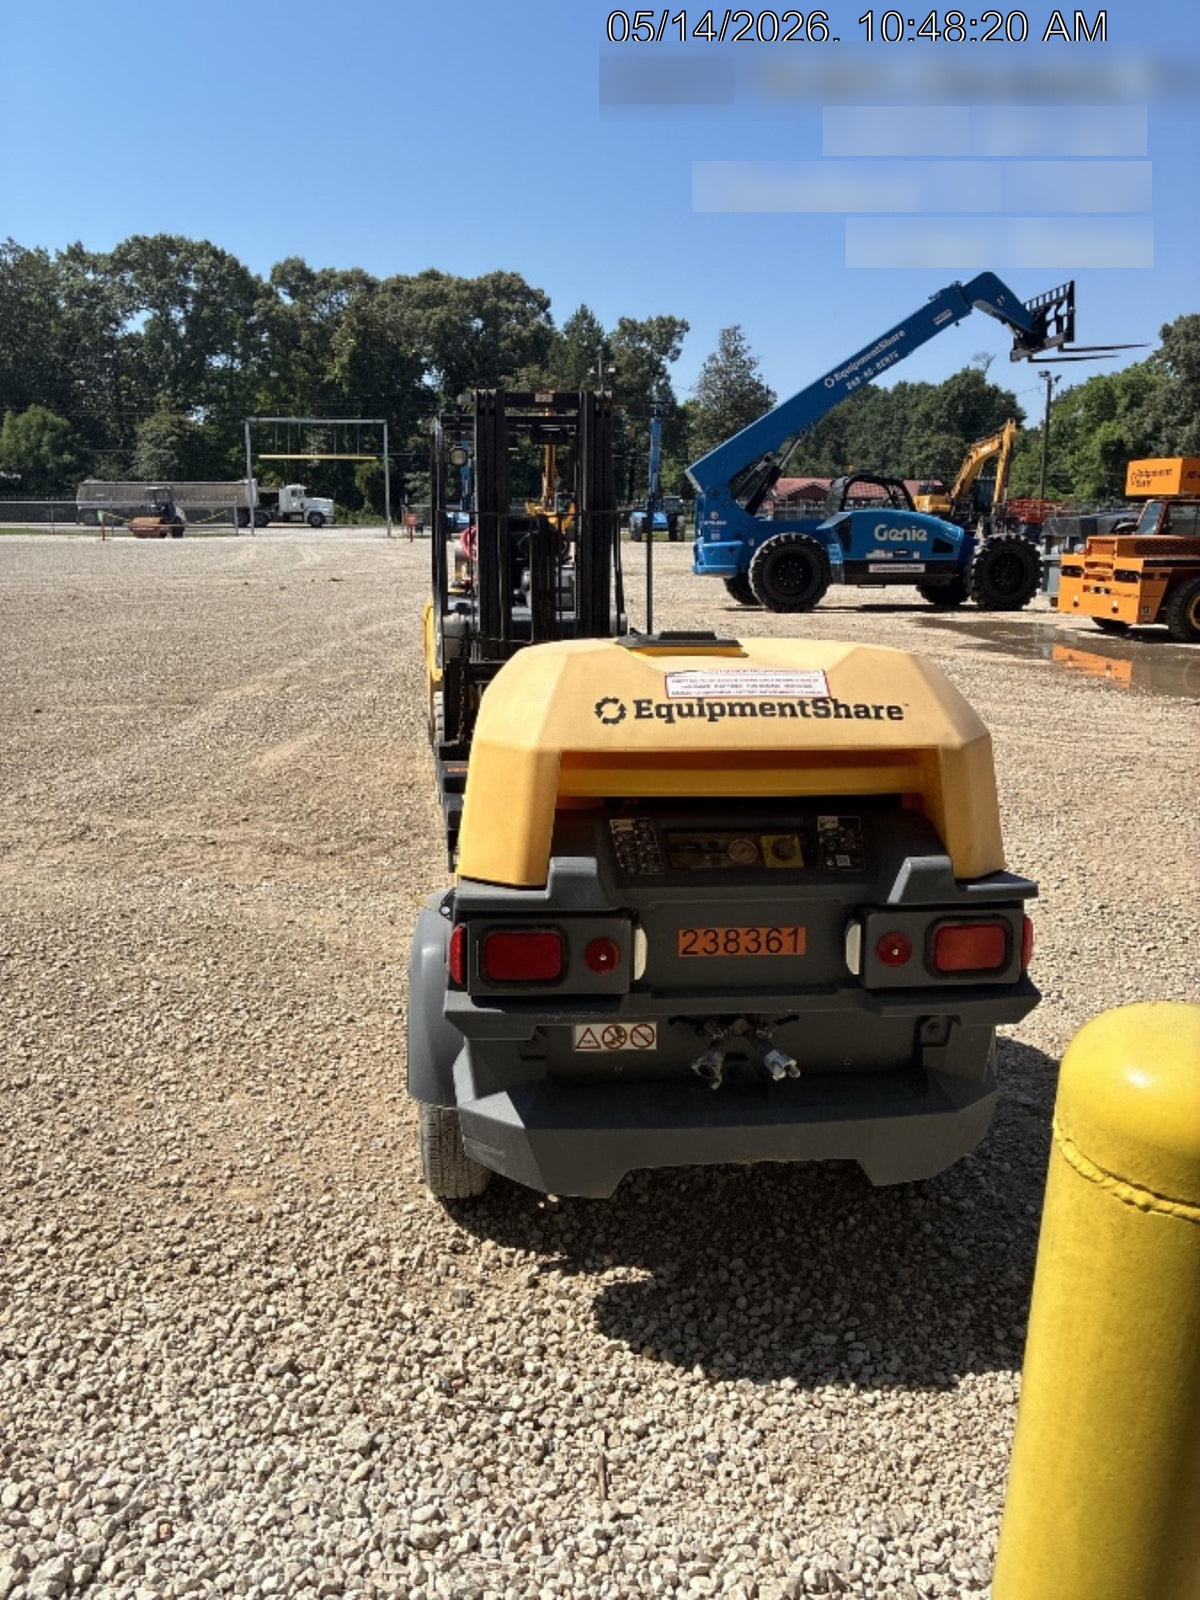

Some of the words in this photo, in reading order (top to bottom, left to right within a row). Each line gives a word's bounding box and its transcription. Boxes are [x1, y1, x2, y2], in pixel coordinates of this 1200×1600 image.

[874, 523, 927, 541] Genie
[633, 696, 905, 724] EquipmentShare
[680, 927, 799, 955] 238361
